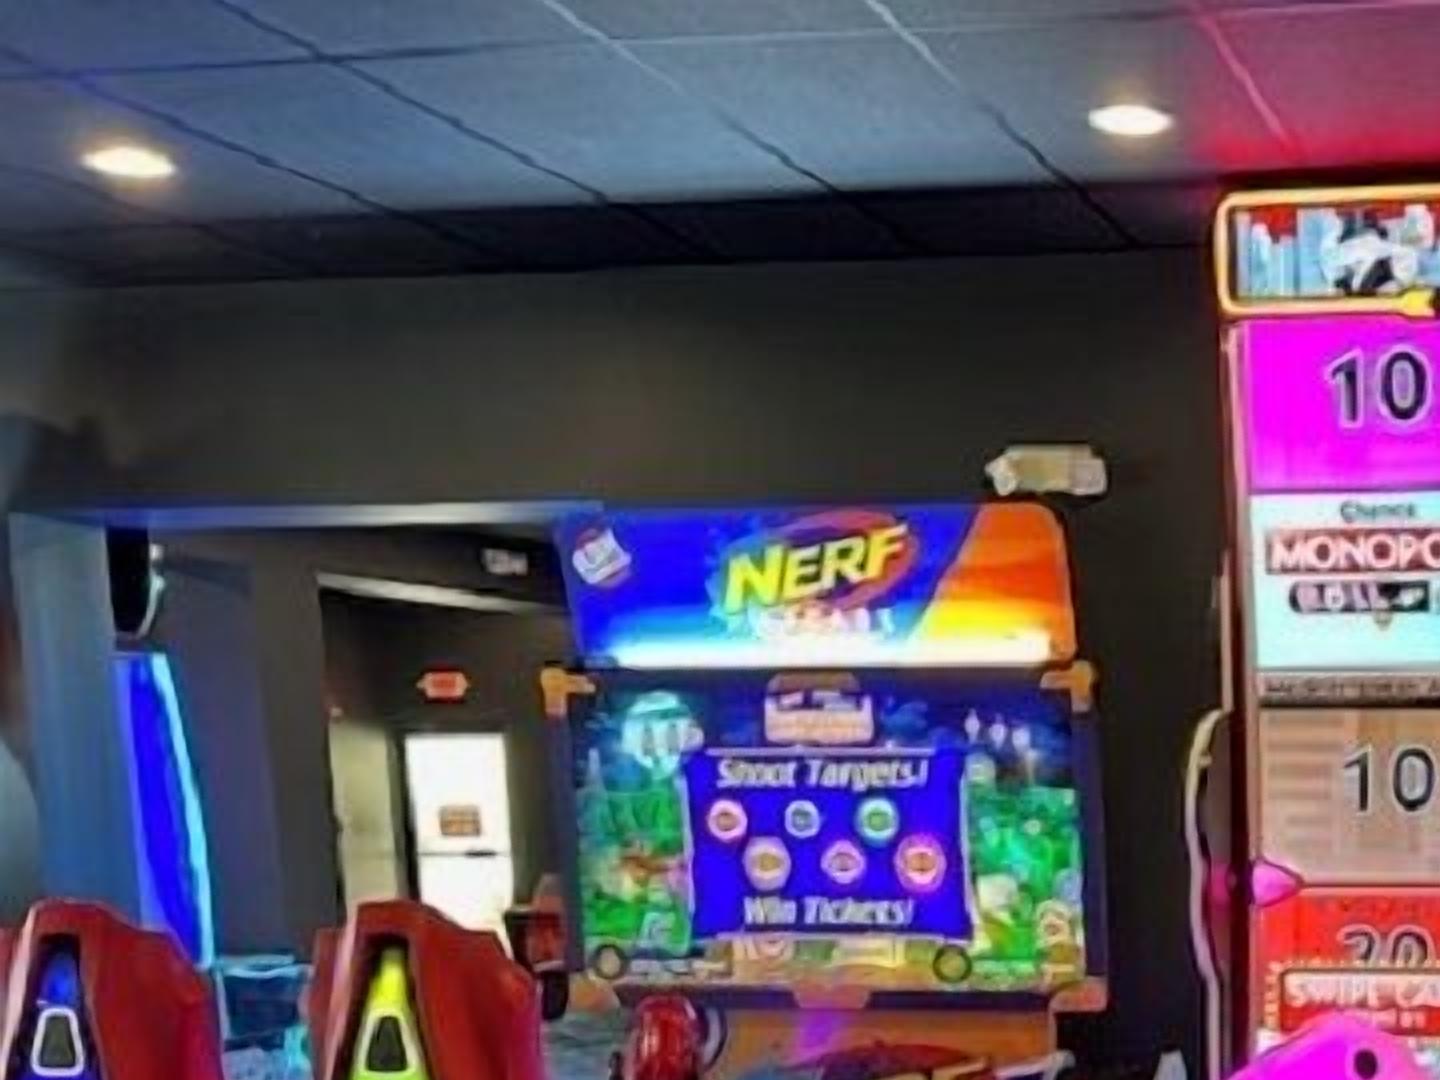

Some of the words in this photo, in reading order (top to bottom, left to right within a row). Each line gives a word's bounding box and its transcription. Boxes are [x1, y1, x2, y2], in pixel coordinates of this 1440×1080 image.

[1328, 347, 1432, 430] 10
[722, 522, 908, 612] NERF
[716, 759, 797, 788] Shoot
[1341, 744, 1438, 815] 10
